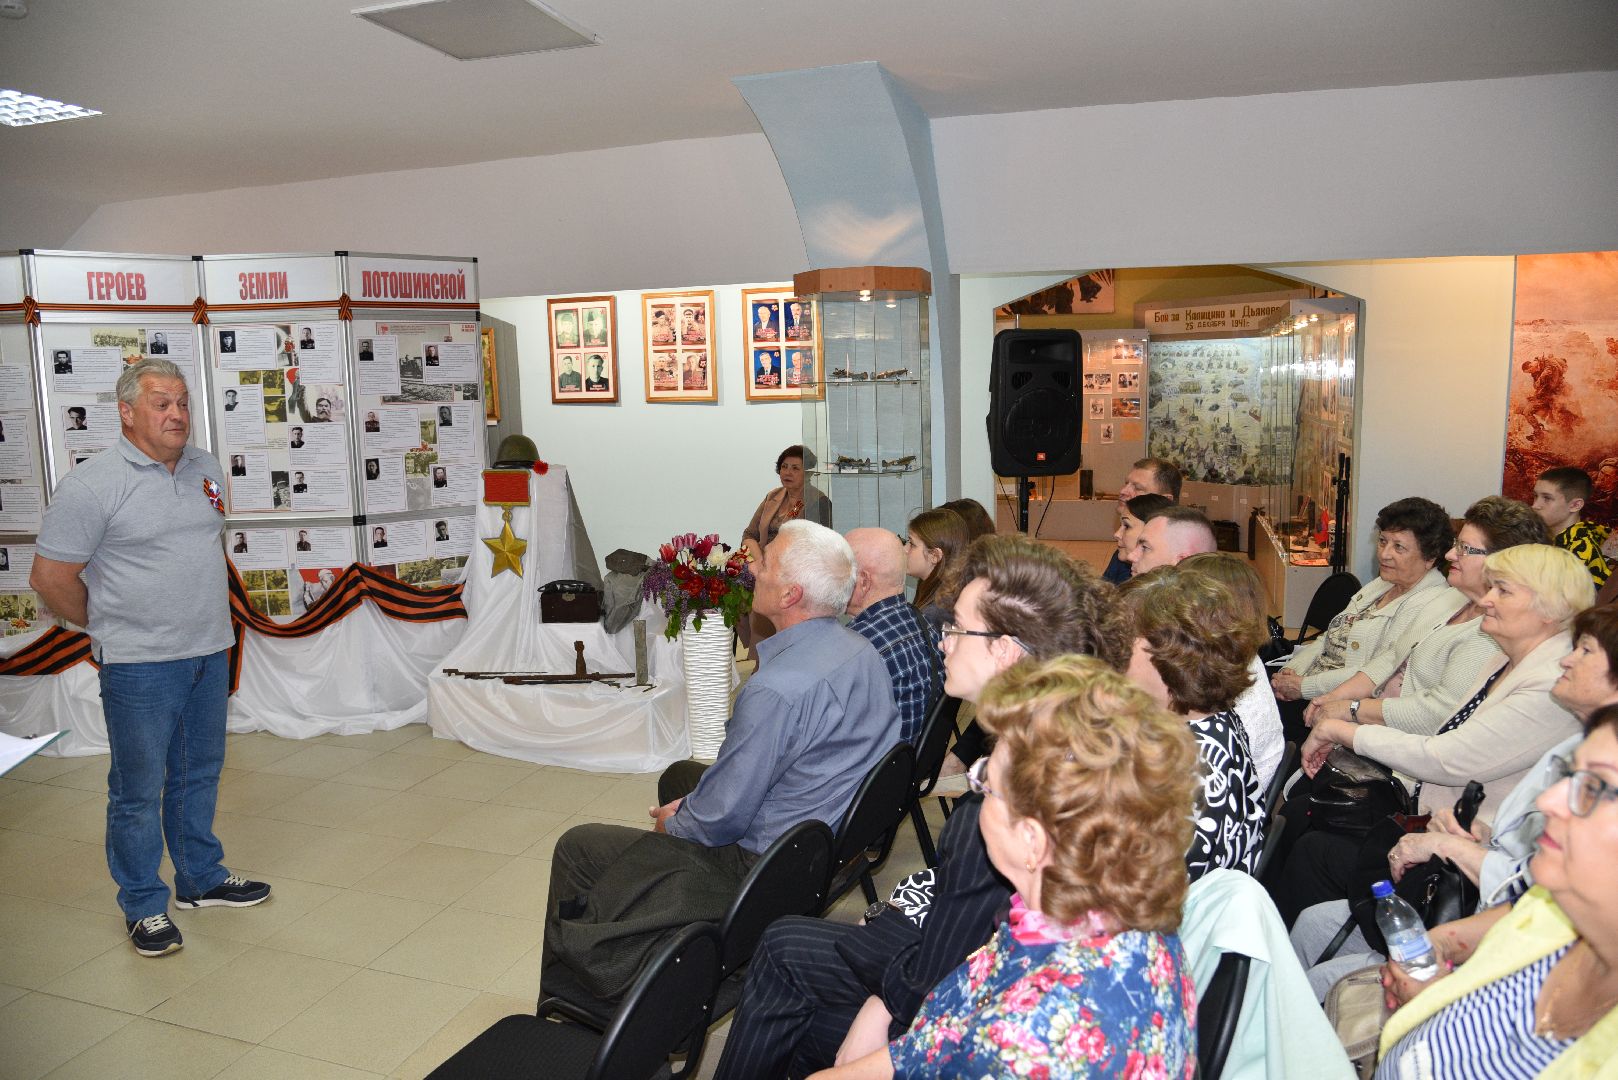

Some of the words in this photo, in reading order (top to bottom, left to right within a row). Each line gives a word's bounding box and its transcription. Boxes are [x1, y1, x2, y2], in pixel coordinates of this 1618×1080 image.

[86, 271, 147, 301] ГЕРОЕВ
[239, 271, 289, 301] ЗЕМЛИ
[361, 268, 466, 300] ЛОТОШИНСКОЙ
[1171, 313, 1180, 322] за
[1230, 309, 1236, 318] и
[1185, 322, 1194, 331] 25
